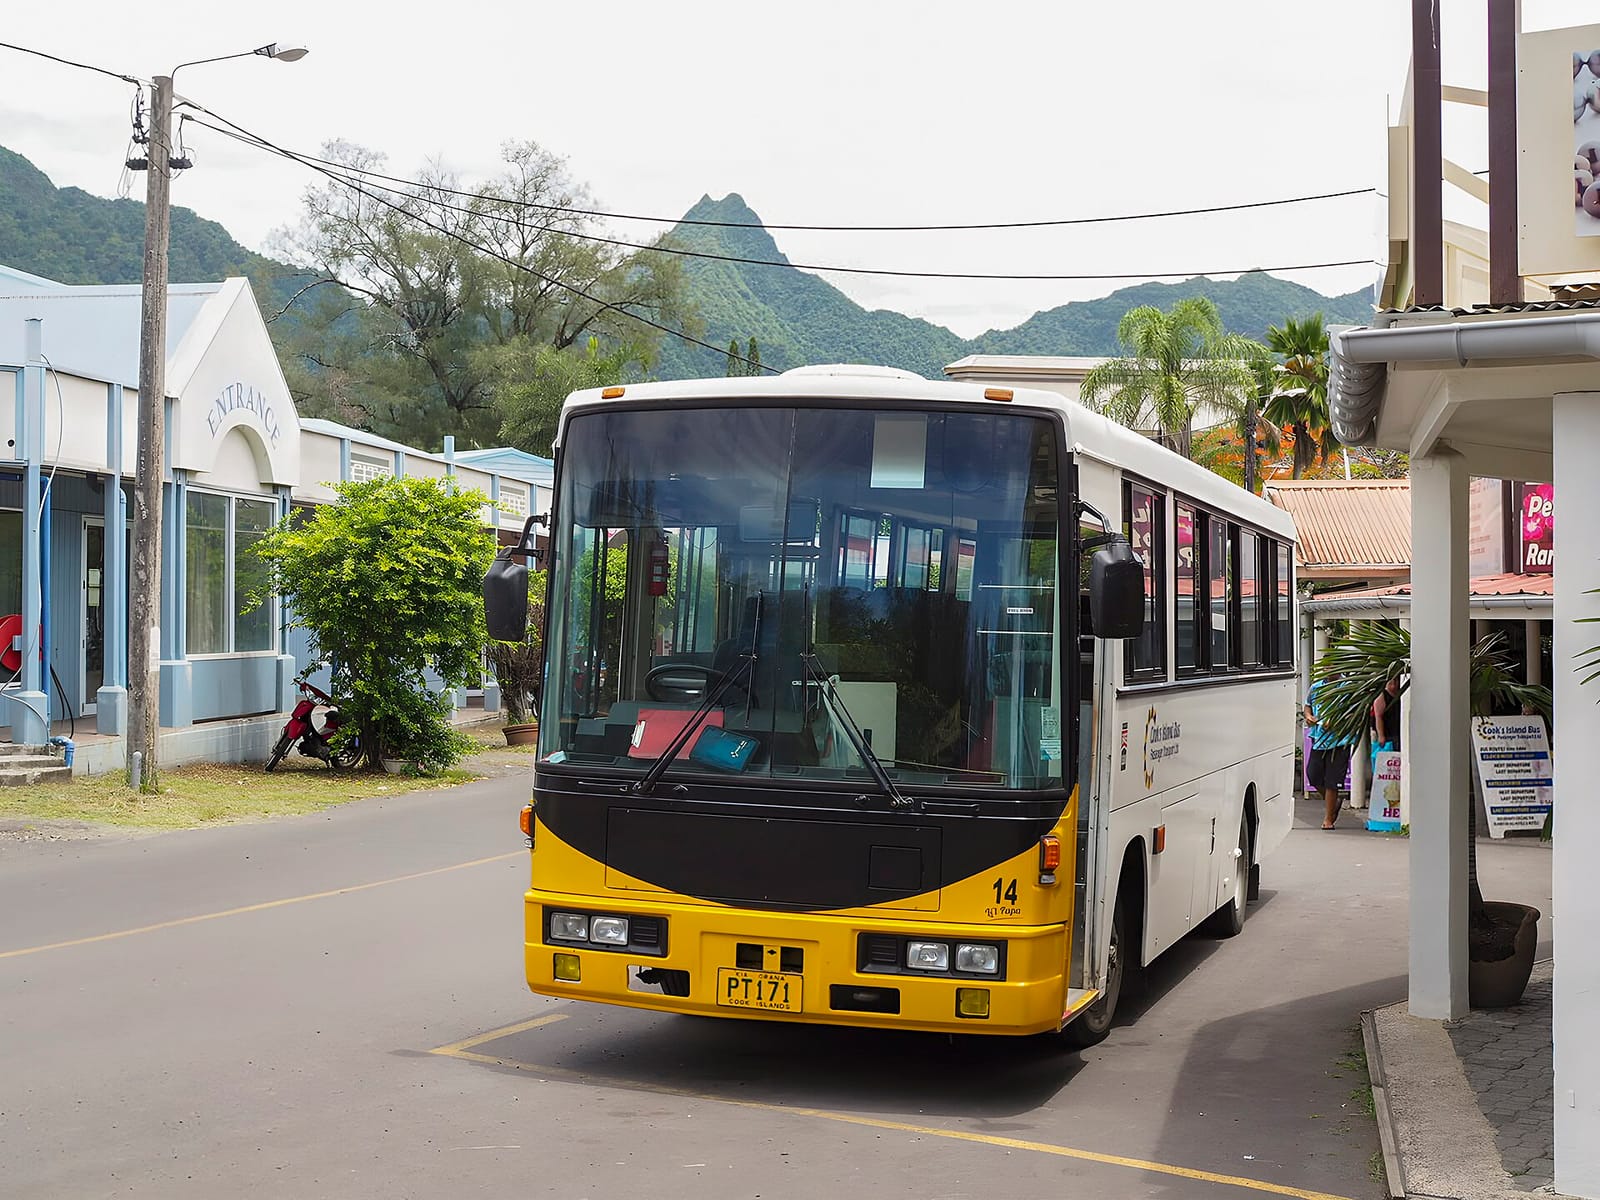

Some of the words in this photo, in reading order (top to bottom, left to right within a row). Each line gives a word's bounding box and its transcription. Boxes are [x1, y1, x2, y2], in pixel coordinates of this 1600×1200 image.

[206, 382, 281, 450] ENTRANCE
[1527, 495, 1553, 518] Pe
[1482, 725, 1505, 735] Cook's
[1506, 725, 1527, 734] Island
[1528, 725, 1541, 734] Bus
[1386, 759, 1401, 768] GE
[1382, 807, 1401, 818] HE
[992, 877, 1018, 906] 14
[727, 977, 789, 1003] PT171
[729, 998, 750, 1006] COOK
[755, 1001, 790, 1010] ISLANDS
